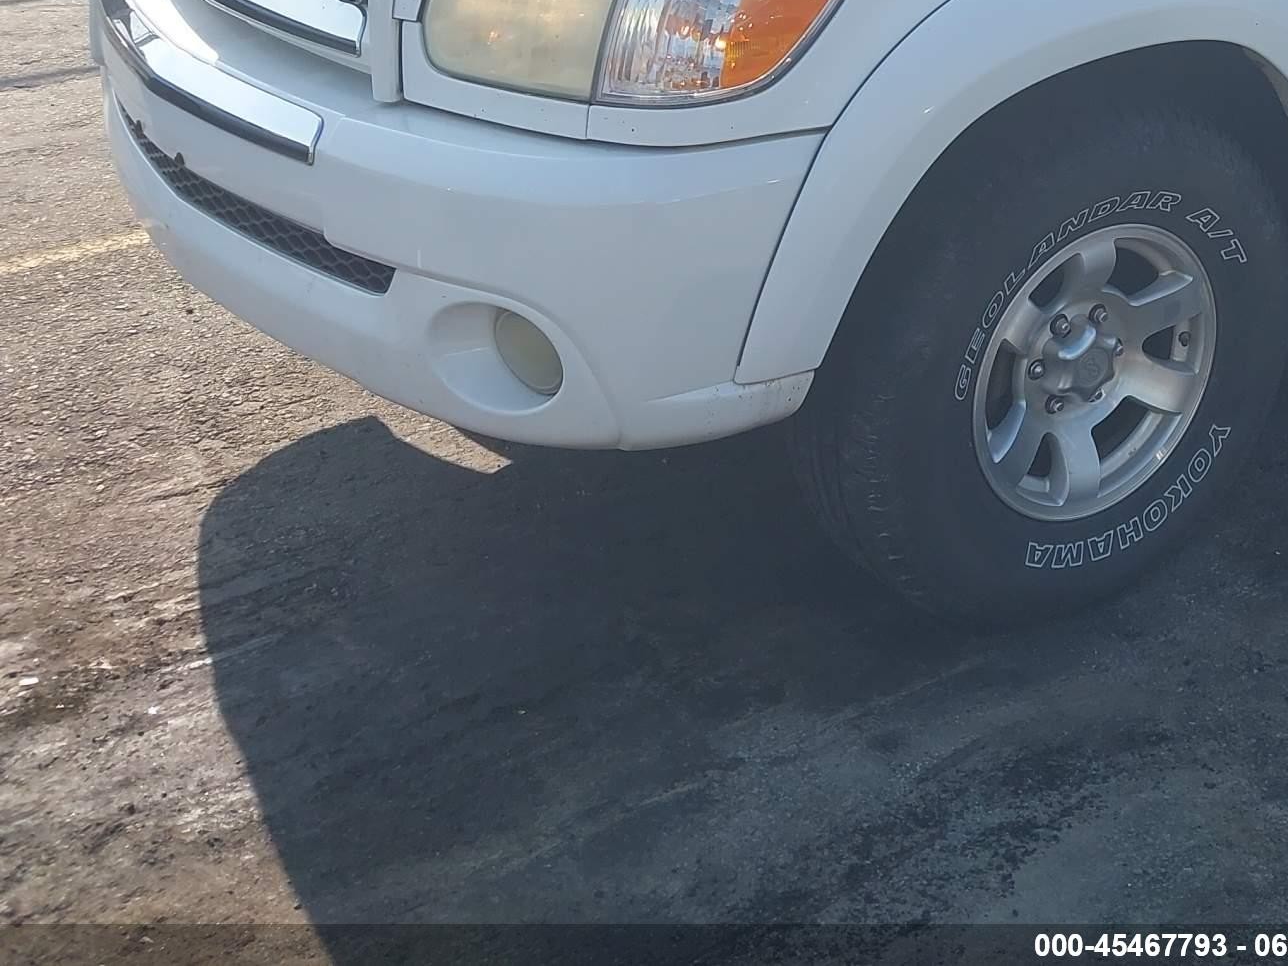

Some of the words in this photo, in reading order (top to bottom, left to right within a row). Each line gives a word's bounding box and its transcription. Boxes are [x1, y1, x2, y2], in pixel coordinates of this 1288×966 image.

[954, 191, 1182, 401] GEOLANDAR
[1186, 207, 1248, 265] A/T
[1025, 423, 1232, 569] YOKOHAMA
